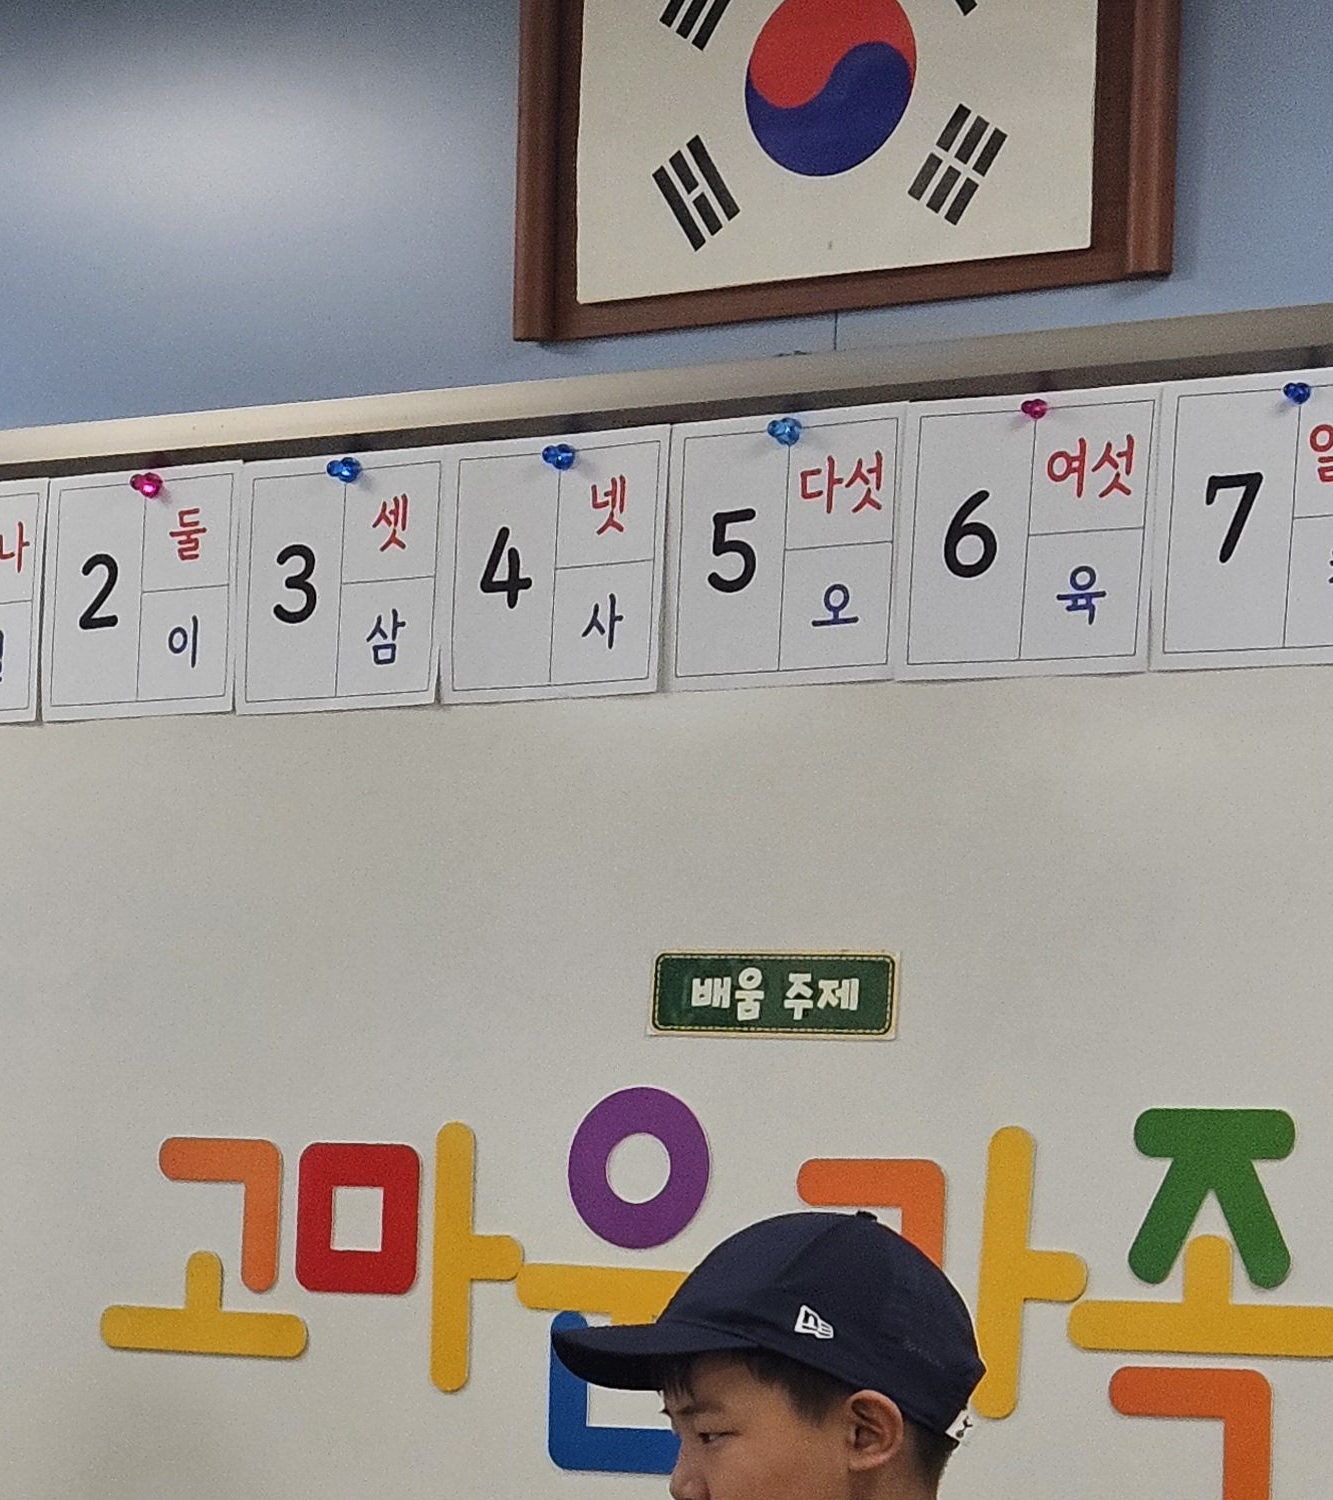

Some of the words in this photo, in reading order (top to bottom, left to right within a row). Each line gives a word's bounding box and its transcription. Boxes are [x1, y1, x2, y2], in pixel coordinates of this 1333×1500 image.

[800, 451, 883, 514] 다섯
[1047, 435, 1135, 498] 여섯
[170, 508, 206, 560] 둘
[372, 494, 410, 551] 셋
[590, 476, 627, 535] 넷
[944, 489, 997, 578] 6
[1205, 472, 1263, 563] 7
[480, 527, 532, 608] 4
[707, 508, 757, 593] 5
[79, 554, 119, 630] 2
[273, 544, 317, 624] 3
[811, 583, 859, 627] 오
[1057, 565, 1107, 624] 육
[169, 616, 199, 668] 이
[366, 609, 405, 665] 삼
[582, 594, 624, 648] 사
[691, 967, 765, 1021] 배움
[784, 973, 860, 1020] 주제
